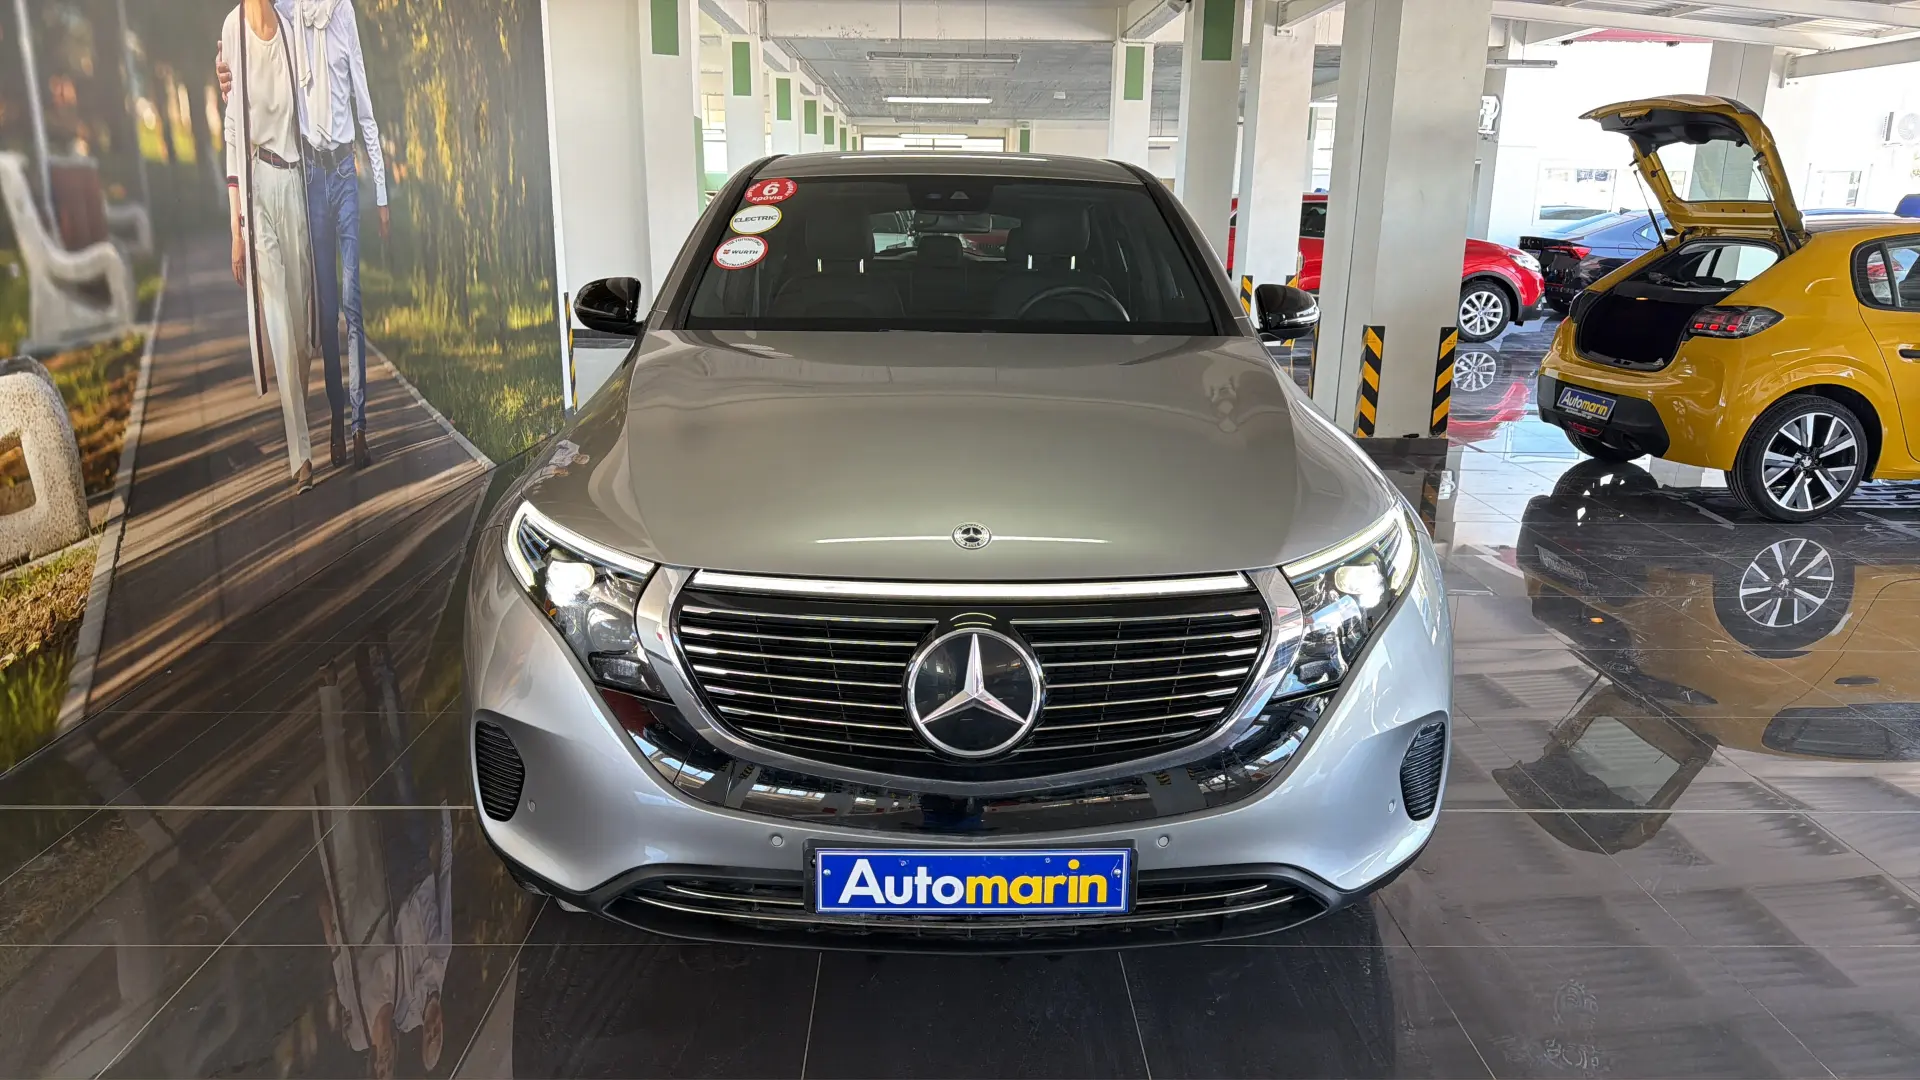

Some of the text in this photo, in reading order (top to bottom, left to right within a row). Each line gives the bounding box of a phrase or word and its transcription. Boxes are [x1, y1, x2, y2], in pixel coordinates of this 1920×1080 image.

[762, 183, 780, 196] 6
[734, 215, 778, 223] ELECTRIC
[1561, 390, 1608, 416] Automarin
[838, 858, 1108, 905] Automarin
